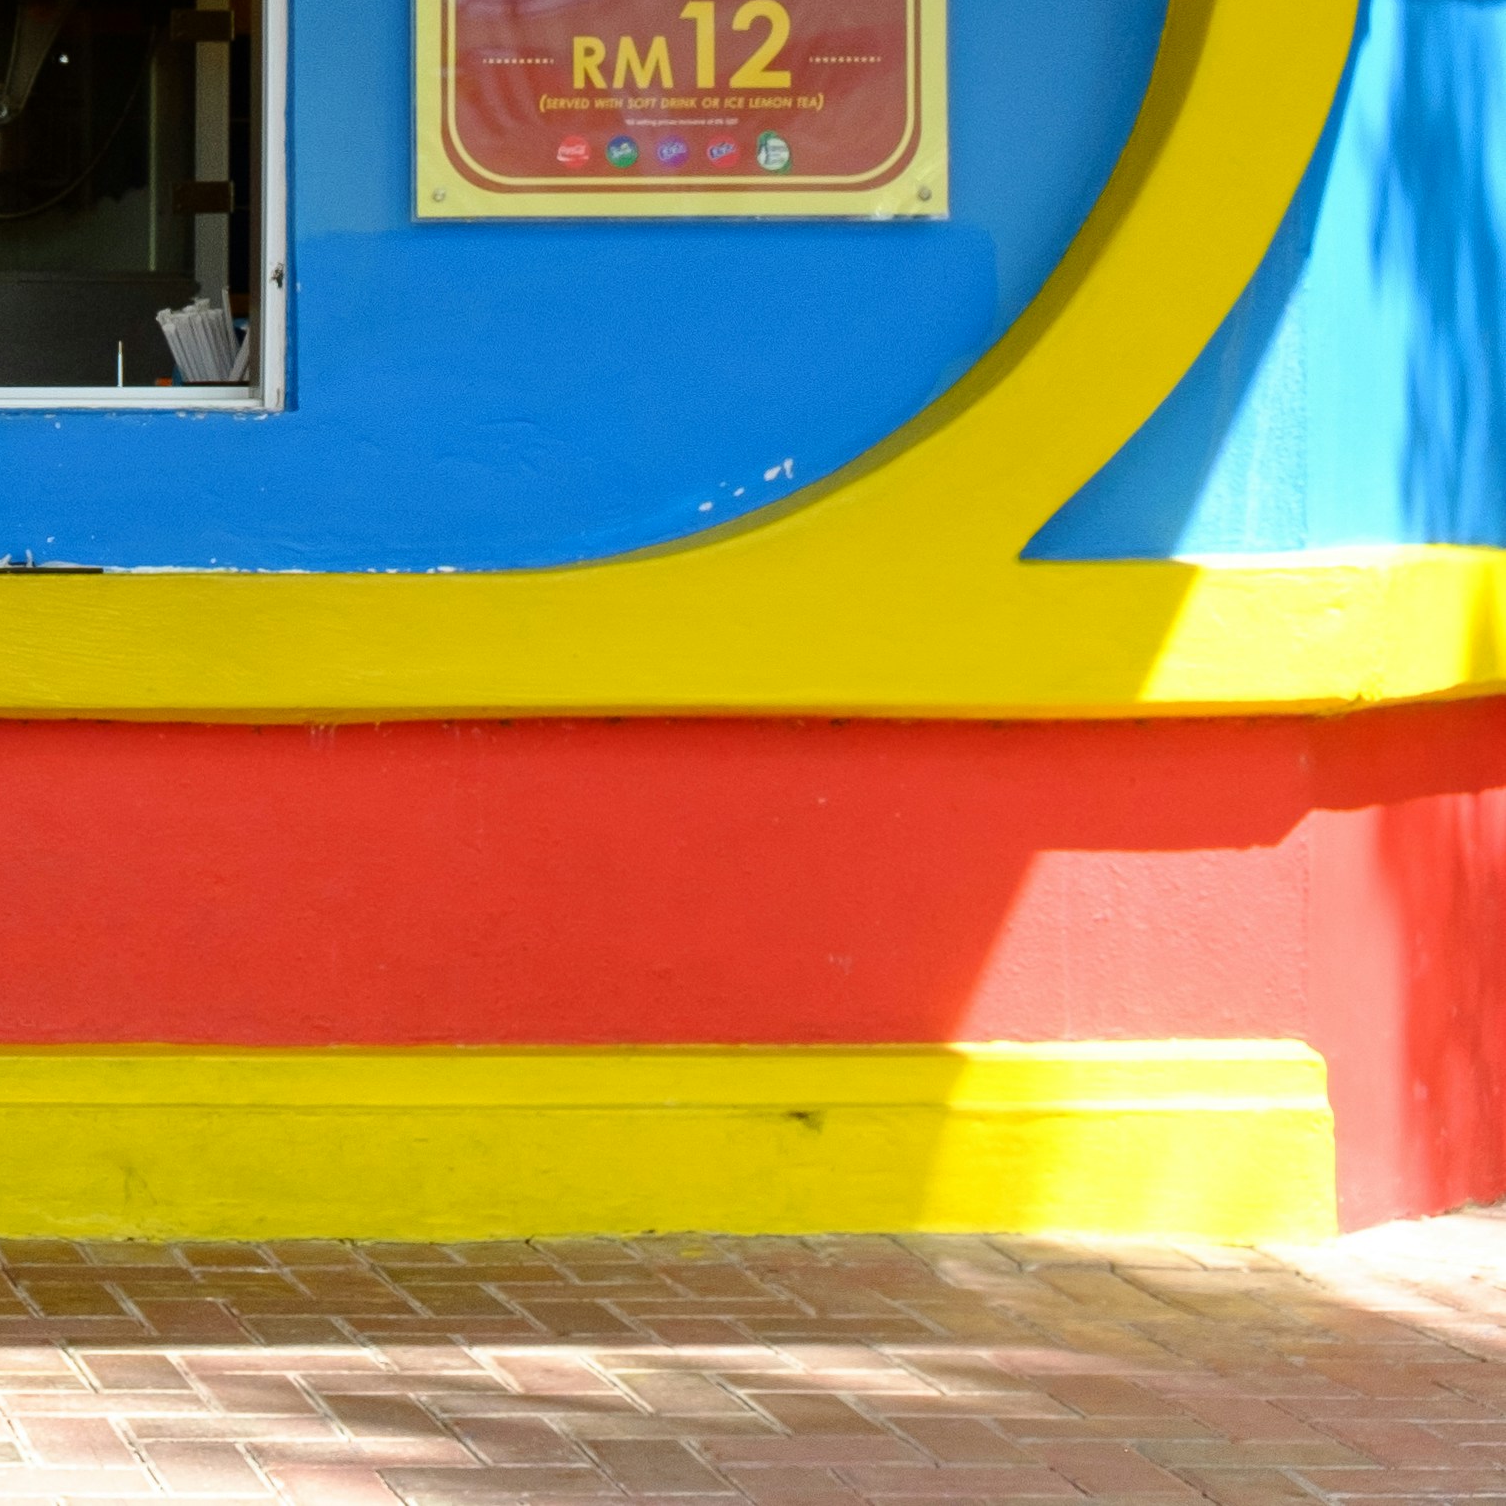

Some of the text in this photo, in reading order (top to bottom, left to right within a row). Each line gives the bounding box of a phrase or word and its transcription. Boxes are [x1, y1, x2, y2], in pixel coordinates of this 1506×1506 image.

[539, 93, 825, 112] (SERVED WITH SOFT DRINK OR ICE LEMON TEA)
